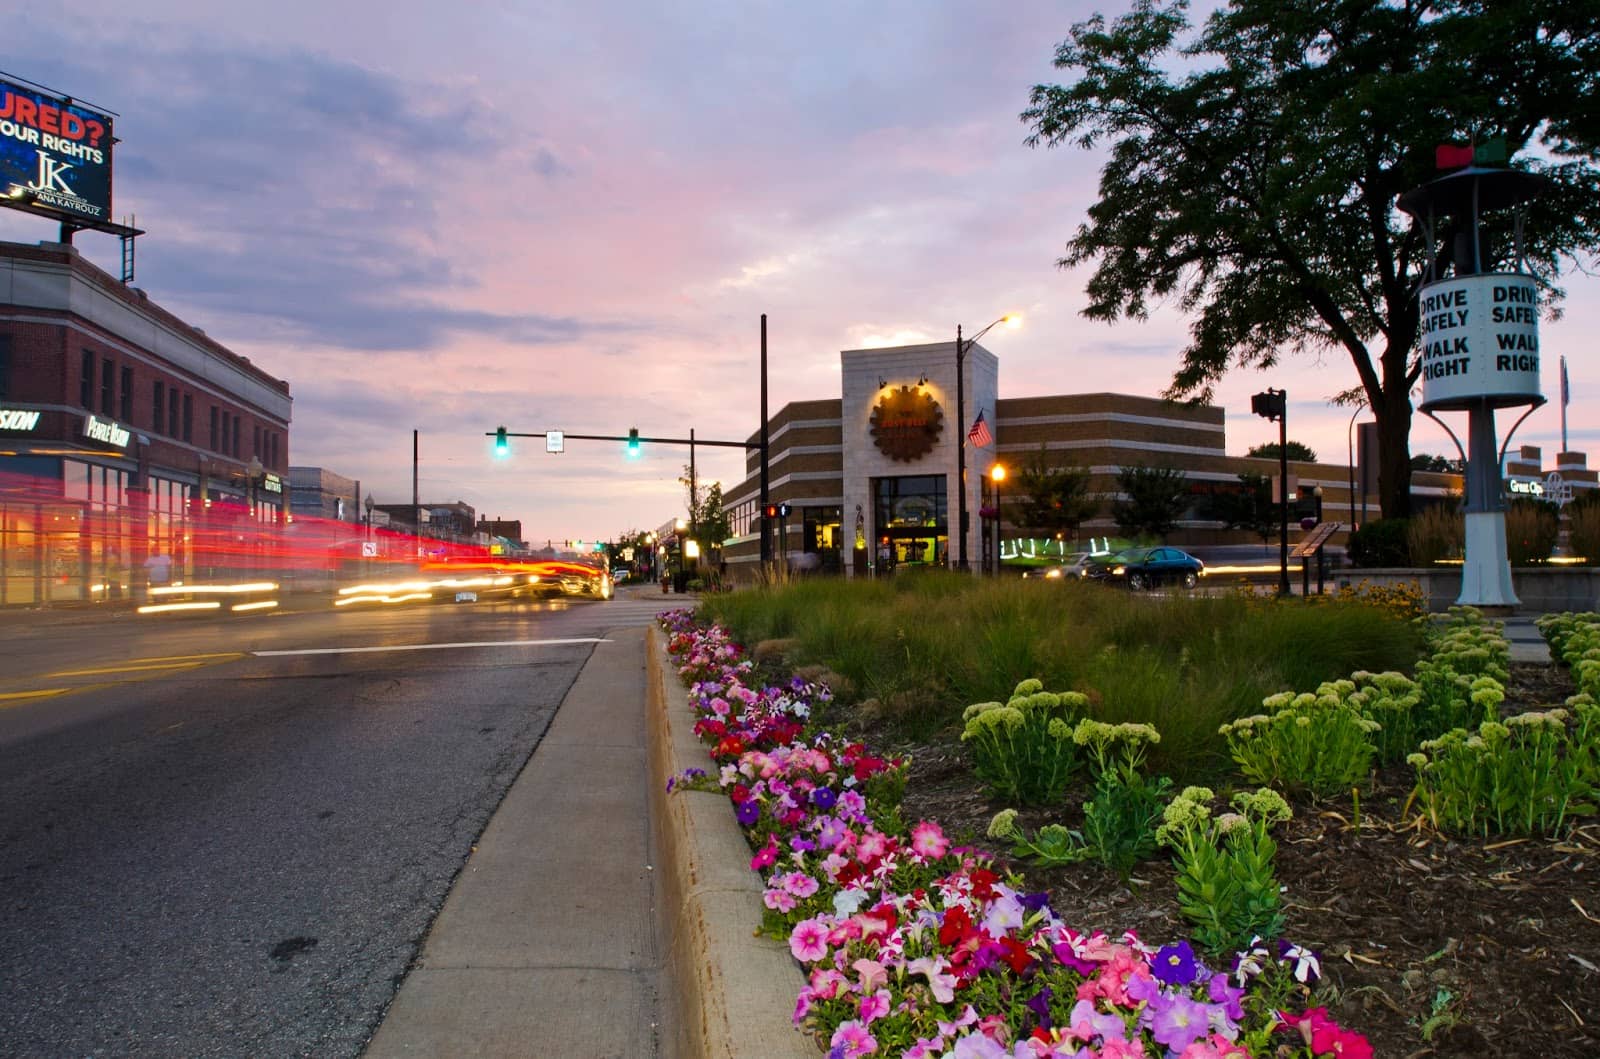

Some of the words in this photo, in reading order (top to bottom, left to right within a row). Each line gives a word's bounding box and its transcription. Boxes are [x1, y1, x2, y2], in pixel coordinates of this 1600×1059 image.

[0, 119, 39, 145] OUR
[42, 133, 104, 164] RIGHTS
[57, 197, 101, 216] KAYROUZ
[1420, 289, 1467, 315] DRIVE
[1421, 309, 1469, 336] SAFELY
[1492, 307, 1538, 325] SAFEL
[1423, 336, 1469, 361] WALK
[1423, 357, 1471, 382] RIGHT
